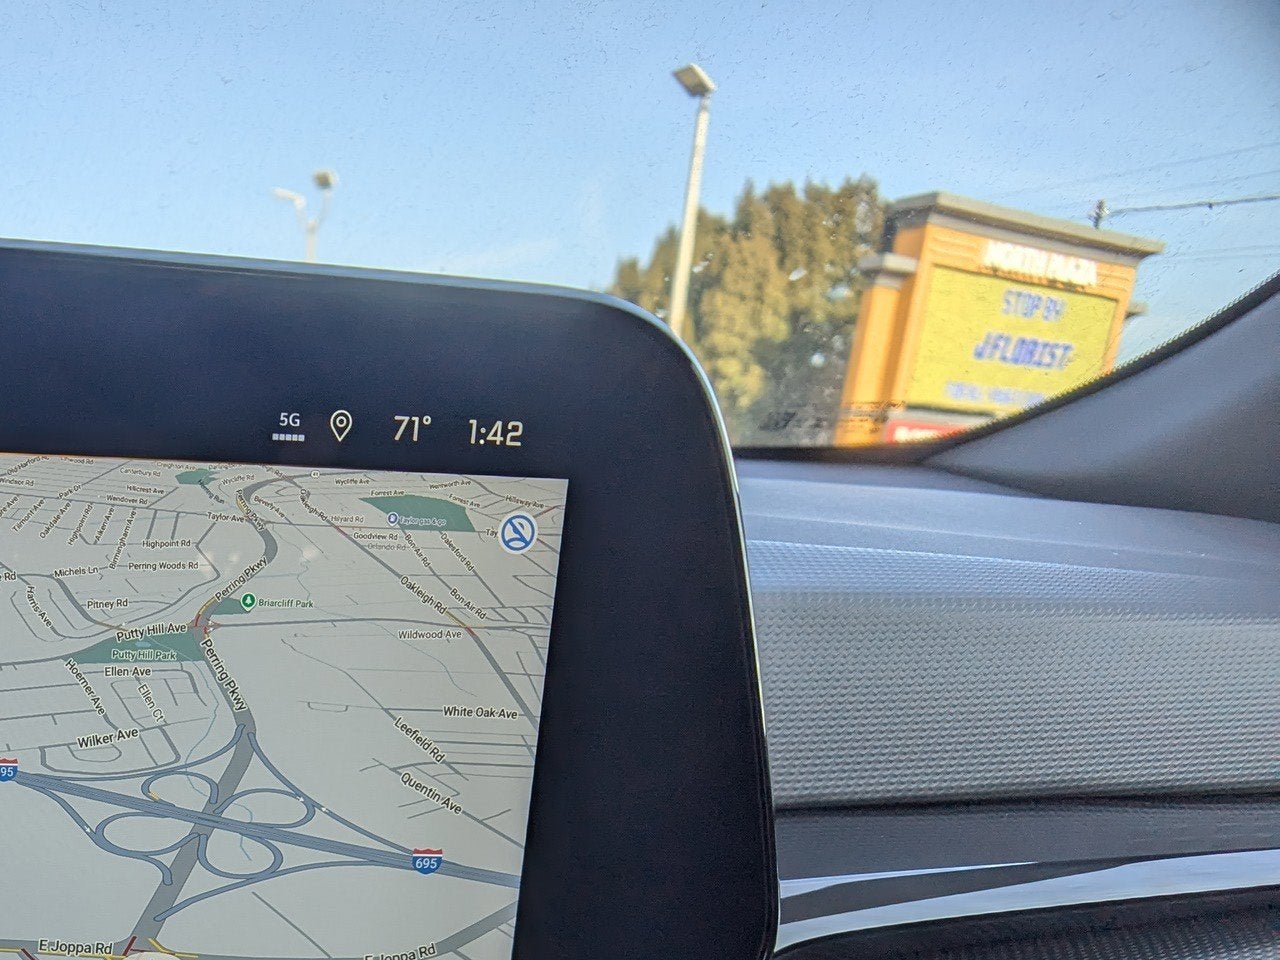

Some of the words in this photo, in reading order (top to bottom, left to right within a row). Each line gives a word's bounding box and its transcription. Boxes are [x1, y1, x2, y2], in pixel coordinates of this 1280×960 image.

[279, 412, 301, 427] 5G
[469, 418, 524, 446] 1:42
[39, 513, 62, 540] Oakdale
[58, 501, 71, 517] Ave
[105, 506, 115, 522] Ave
[108, 524, 131, 570] Birmingham
[127, 509, 137, 527] Ave
[142, 539, 179, 548] Highpoint
[180, 539, 191, 547] Rd
[388, 533, 398, 541] Rd
[128, 561, 155, 572] Perring
[156, 561, 186, 570] Woods
[187, 561, 199, 569] Rd
[3, 571, 17, 581] Rd
[214, 571, 247, 601] Perring
[244, 557, 268, 580] Pkwy
[258, 598, 294, 608] Briarcliff
[295, 599, 314, 608] Park
[400, 575, 435, 608] Oakleigh
[433, 601, 448, 616] Rd
[26, 585, 41, 617] Harris
[37, 610, 53, 628] Ave
[87, 600, 115, 610] Pitney
[115, 599, 129, 608] Rd
[116, 627, 145, 643] Putty
[147, 624, 165, 636] Hill
[166, 622, 187, 634] Ave
[398, 630, 443, 640] Wildwood
[445, 630, 462, 639] Ave
[112, 650, 136, 661] Putty
[136, 650, 154, 660] Hill
[155, 651, 176, 661] Park
[104, 666, 130, 677] Ellen
[131, 667, 152, 677] Ave
[201, 638, 229, 683] Perring
[224, 678, 247, 711] Pkwy
[89, 694, 106, 715] Ave
[136, 683, 158, 710] Ellen
[152, 706, 164, 722] Ct
[443, 706, 473, 717] White
[475, 707, 495, 718] Oak
[496, 709, 518, 720] Ave
[77, 732, 115, 749] Wilker
[116, 728, 139, 740] Ave
[393, 716, 433, 752] Leefield
[428, 746, 446, 764] Rd
[400, 771, 442, 804] Quentin
[440, 796, 463, 815] Ave
[415, 857, 438, 870] 695
[38, 939, 48, 951] E
[50, 940, 92, 955] Joppa
[95, 942, 113, 955] Rd
[418, 943, 436, 958] Rd
